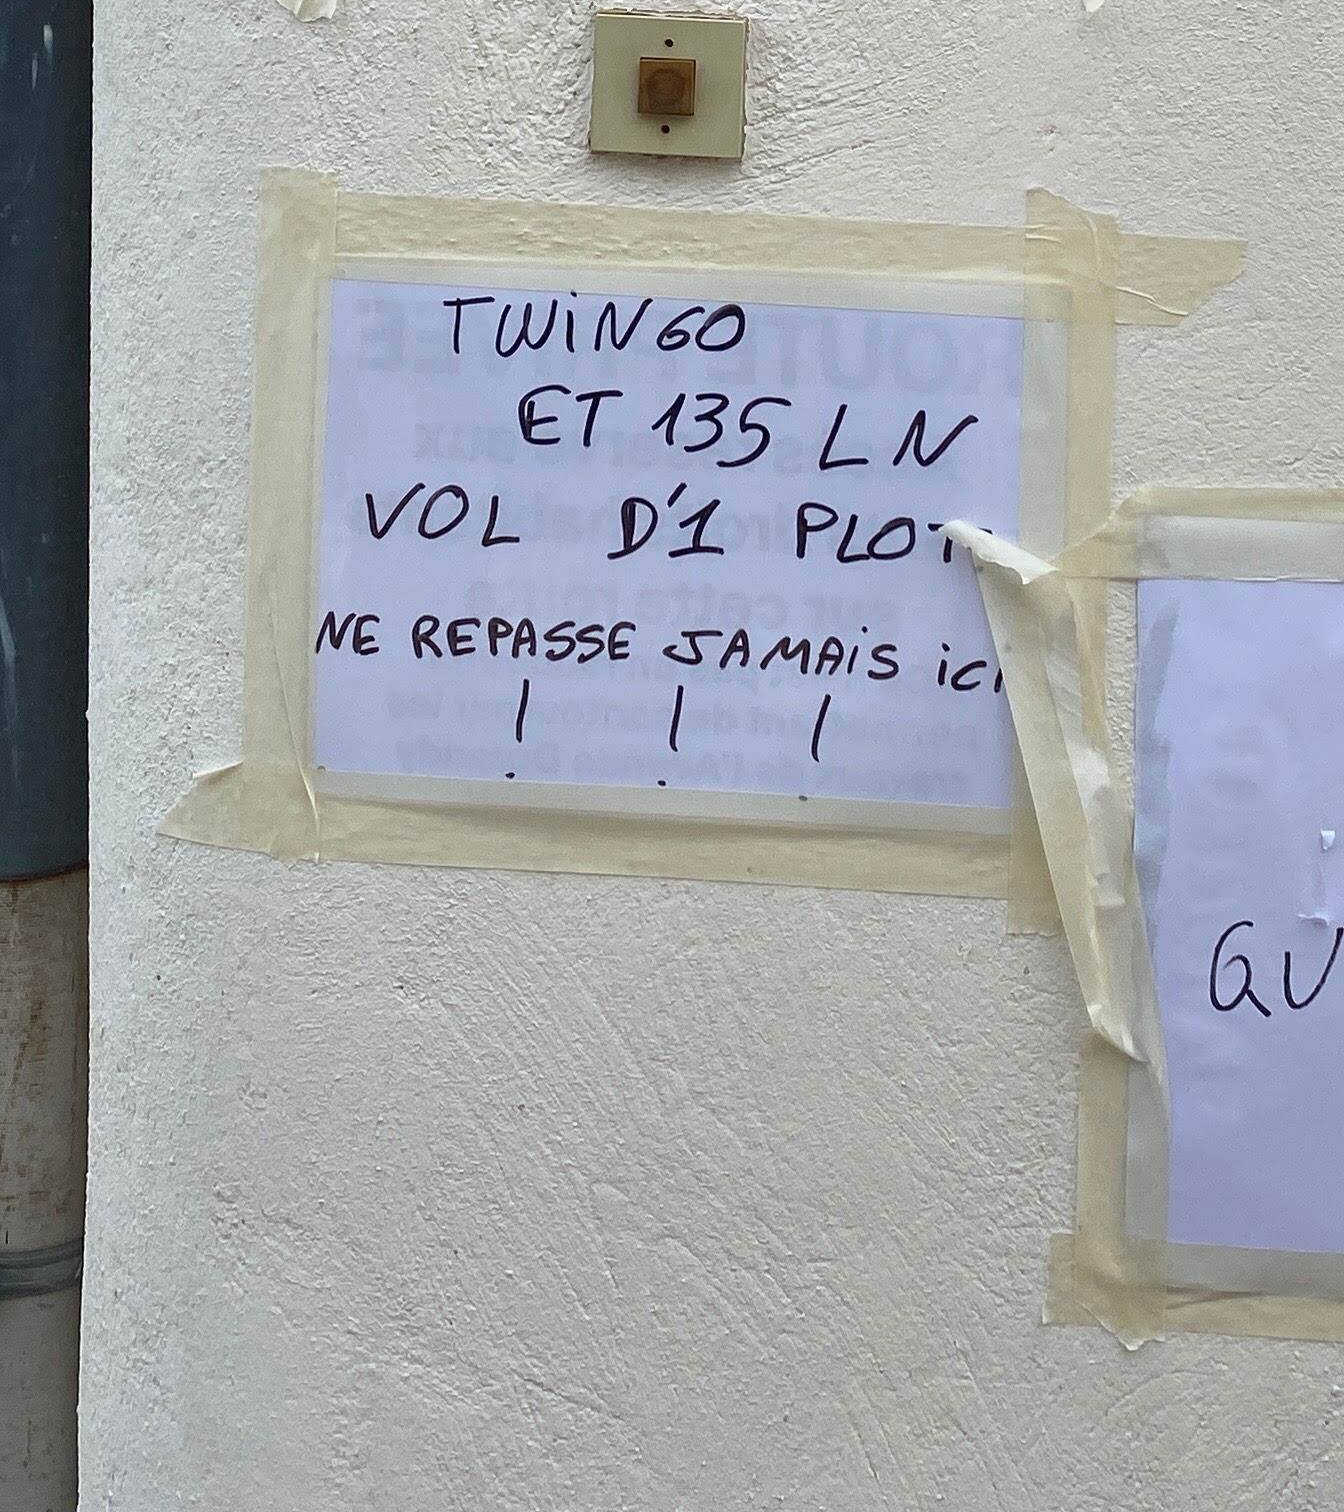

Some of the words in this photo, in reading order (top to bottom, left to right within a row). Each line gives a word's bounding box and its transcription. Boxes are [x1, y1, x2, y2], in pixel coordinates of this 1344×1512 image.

[518, 385, 623, 447] ET
[652, 393, 791, 467] 135
[366, 483, 520, 547] VOL
[316, 611, 379, 655] NE
[411, 612, 637, 664] REPASSE
